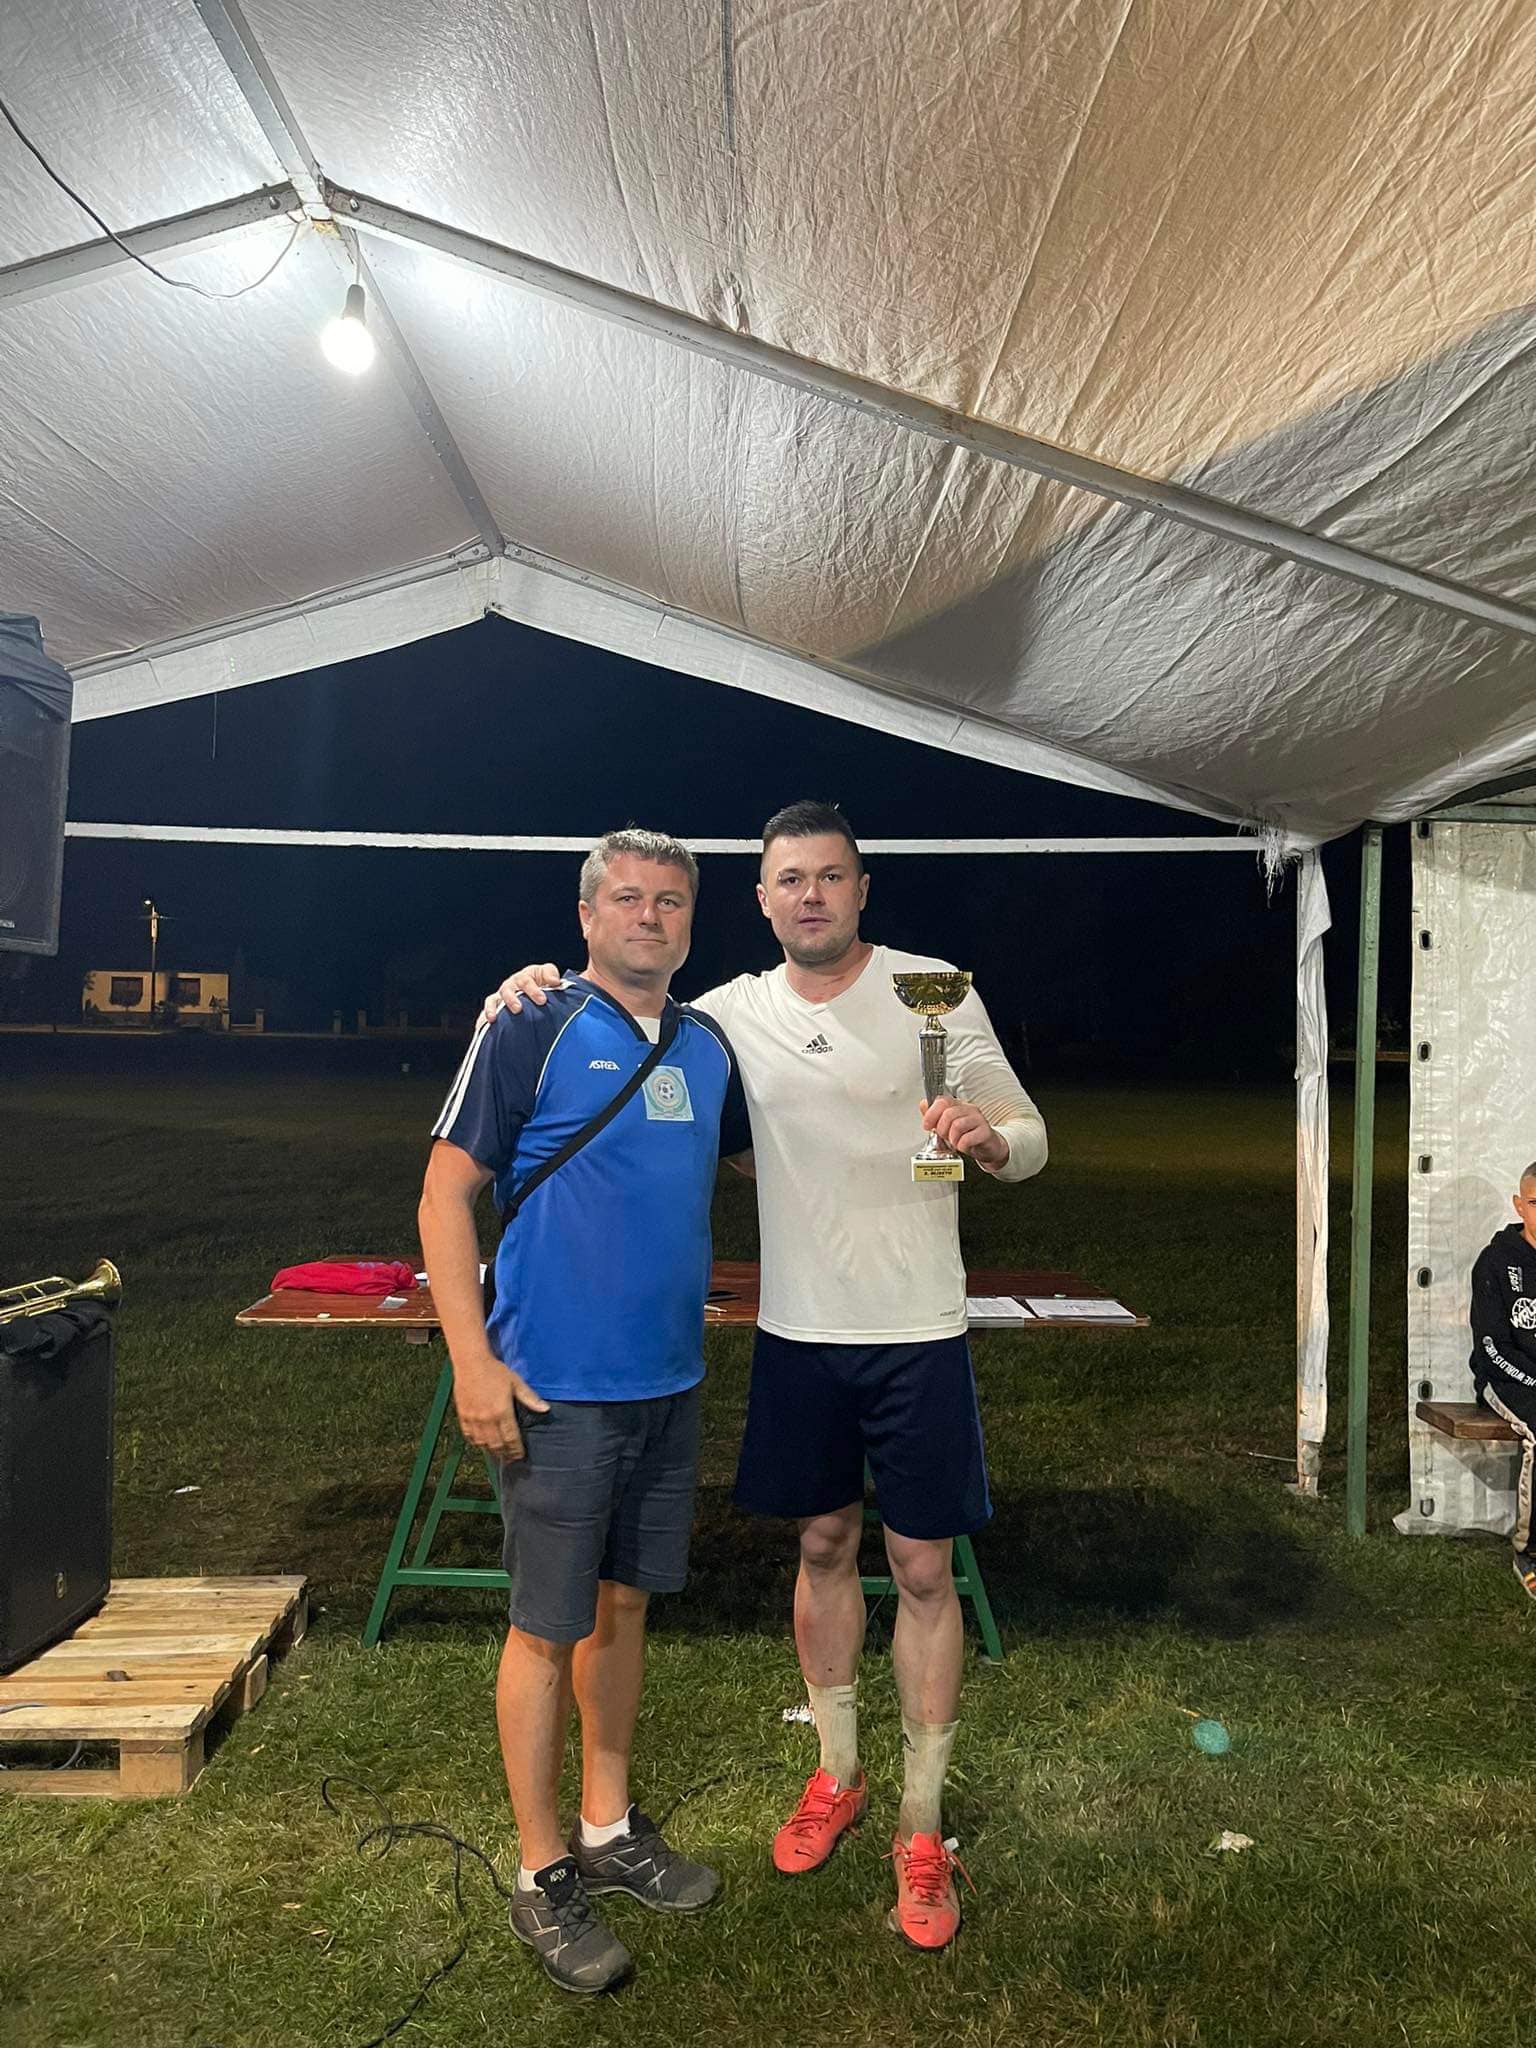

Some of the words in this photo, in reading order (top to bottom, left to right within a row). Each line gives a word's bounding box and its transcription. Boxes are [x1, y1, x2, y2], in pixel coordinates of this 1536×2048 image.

[801, 1045, 834, 1055] adidas
[1492, 1355, 1505, 1366] IS
[1499, 1360, 1526, 1381] WORLD
[1522, 1375, 1536, 1387] HE
